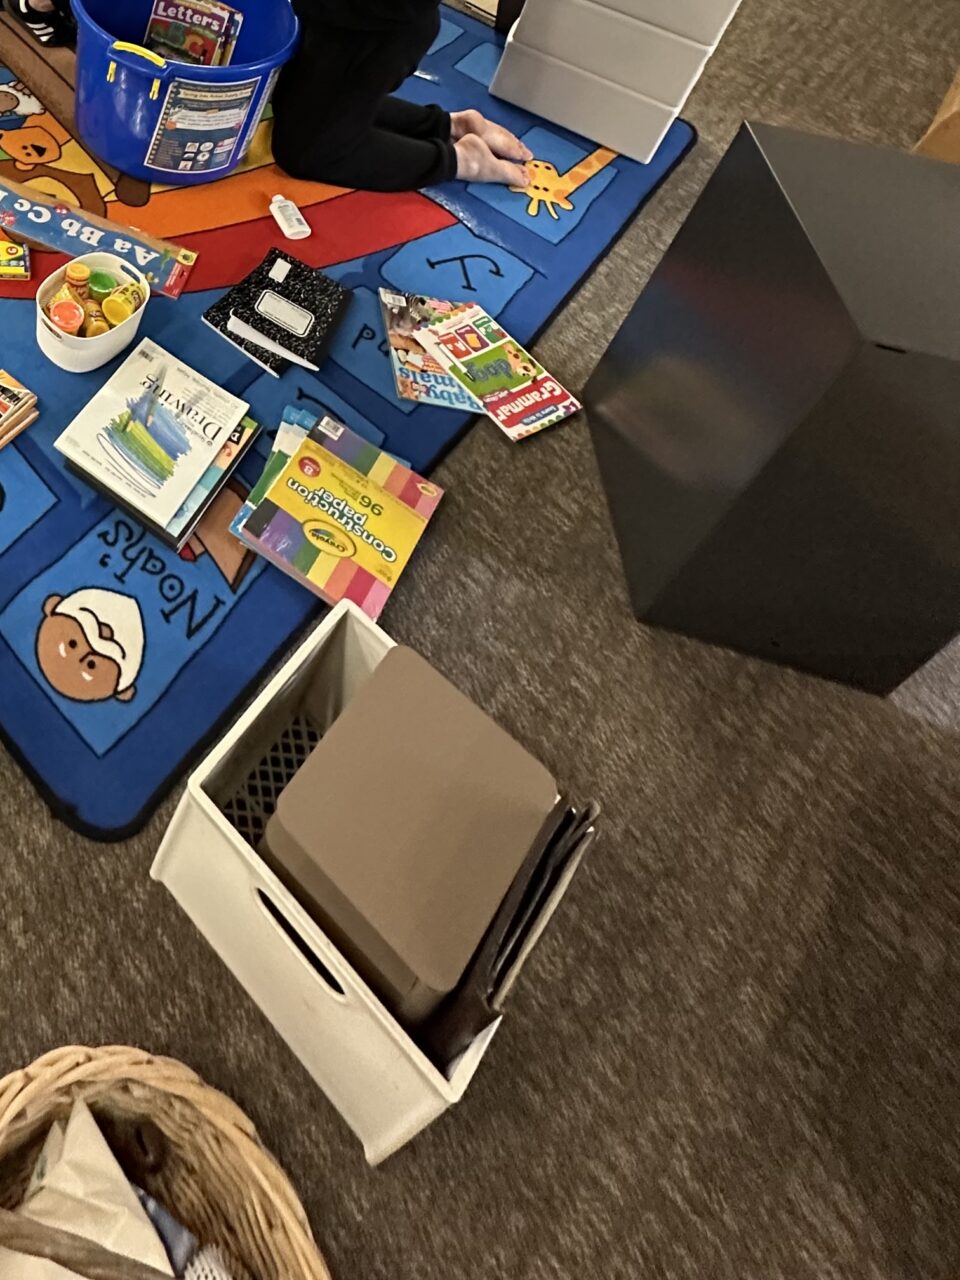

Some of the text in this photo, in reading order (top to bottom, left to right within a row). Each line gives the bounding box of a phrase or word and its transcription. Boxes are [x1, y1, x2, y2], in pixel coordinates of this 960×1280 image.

[156, 1, 221, 33] Letters
[13, 197, 54, 227] Cc
[59, 215, 105, 249] Bb
[111, 235, 161, 271] Aa
[140, 374, 223, 442] Drawing
[496, 380, 562, 421] Grammar
[287, 477, 397, 563] Construction
[315, 487, 368, 527] paper
[96, 517, 226, 640] Noah's
